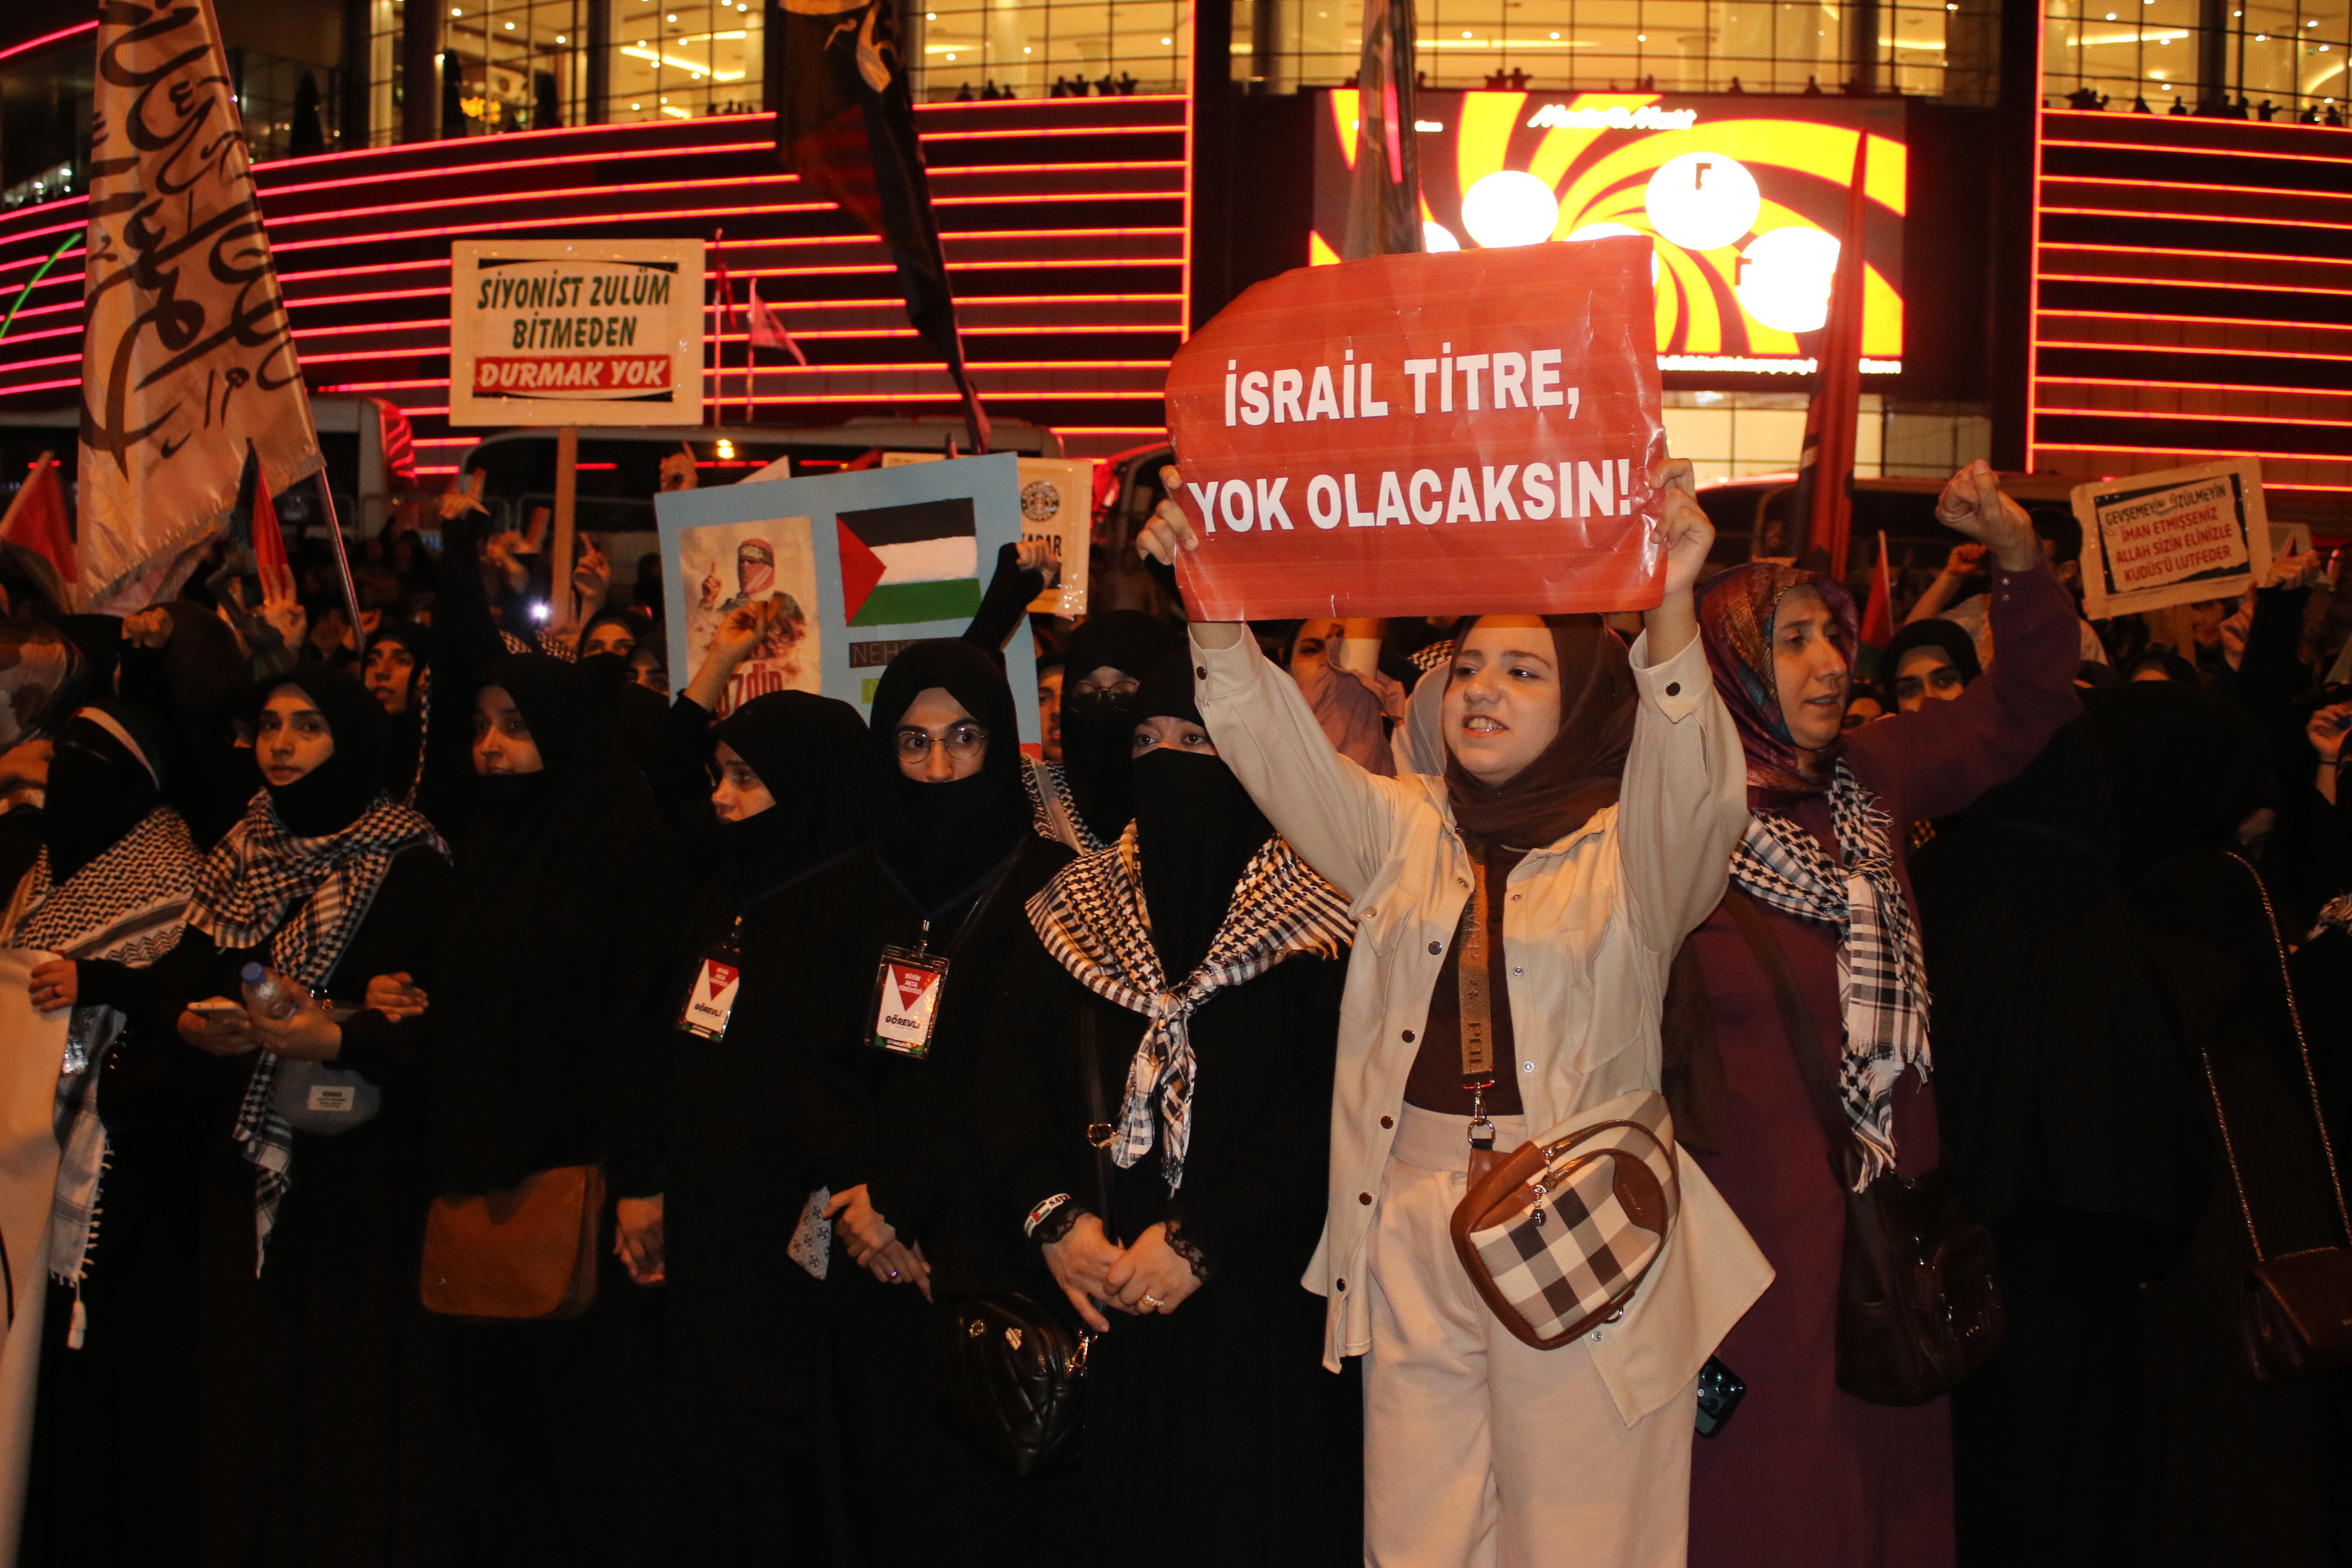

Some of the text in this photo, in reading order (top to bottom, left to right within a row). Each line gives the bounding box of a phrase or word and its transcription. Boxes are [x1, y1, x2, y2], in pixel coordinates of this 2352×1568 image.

[478, 268, 671, 309] SİYONİST ZULÜM
[512, 311, 637, 349] BİTMEDEN
[479, 359, 668, 387] DURMAK YOK
[1224, 341, 1580, 427] İSRAİL TİTRE,
[1187, 458, 1632, 533] YOK OLACAKSIN!
[2115, 523, 2233, 565] ALLAH SİZİN ELİNİZLE
[2121, 523, 2151, 542] İMAN
[2175, 544, 2232, 570] LUTFEDER
[885, 1014, 921, 1029] GÖREVLİ
